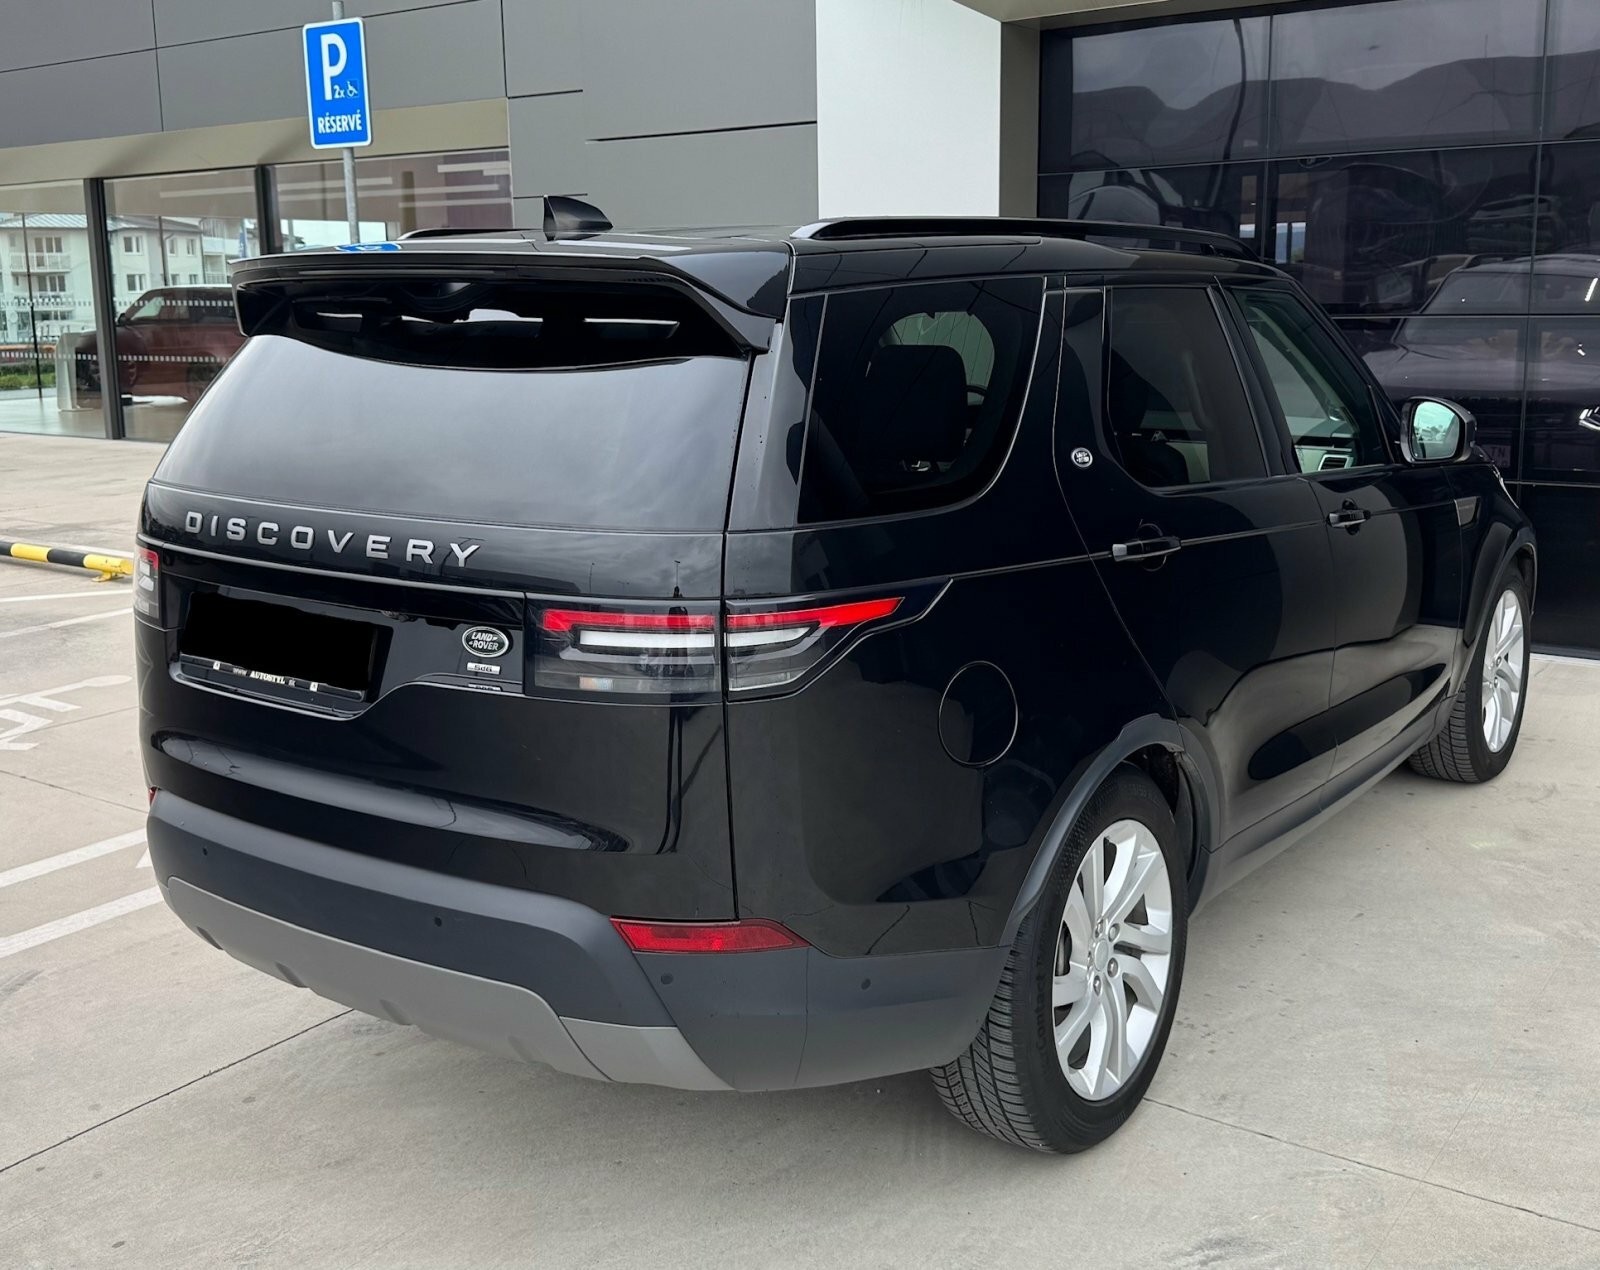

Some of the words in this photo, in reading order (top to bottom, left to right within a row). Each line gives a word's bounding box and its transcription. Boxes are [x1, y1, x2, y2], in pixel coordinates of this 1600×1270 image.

[320, 33, 348, 101] P
[333, 85, 346, 99] 2x
[317, 109, 363, 134] RÉSERVÉ
[185, 511, 480, 568] DISCOVERY
[471, 631, 494, 642] LAND
[472, 640, 499, 651] ROVER
[249, 670, 286, 685] AUTOSTYL
